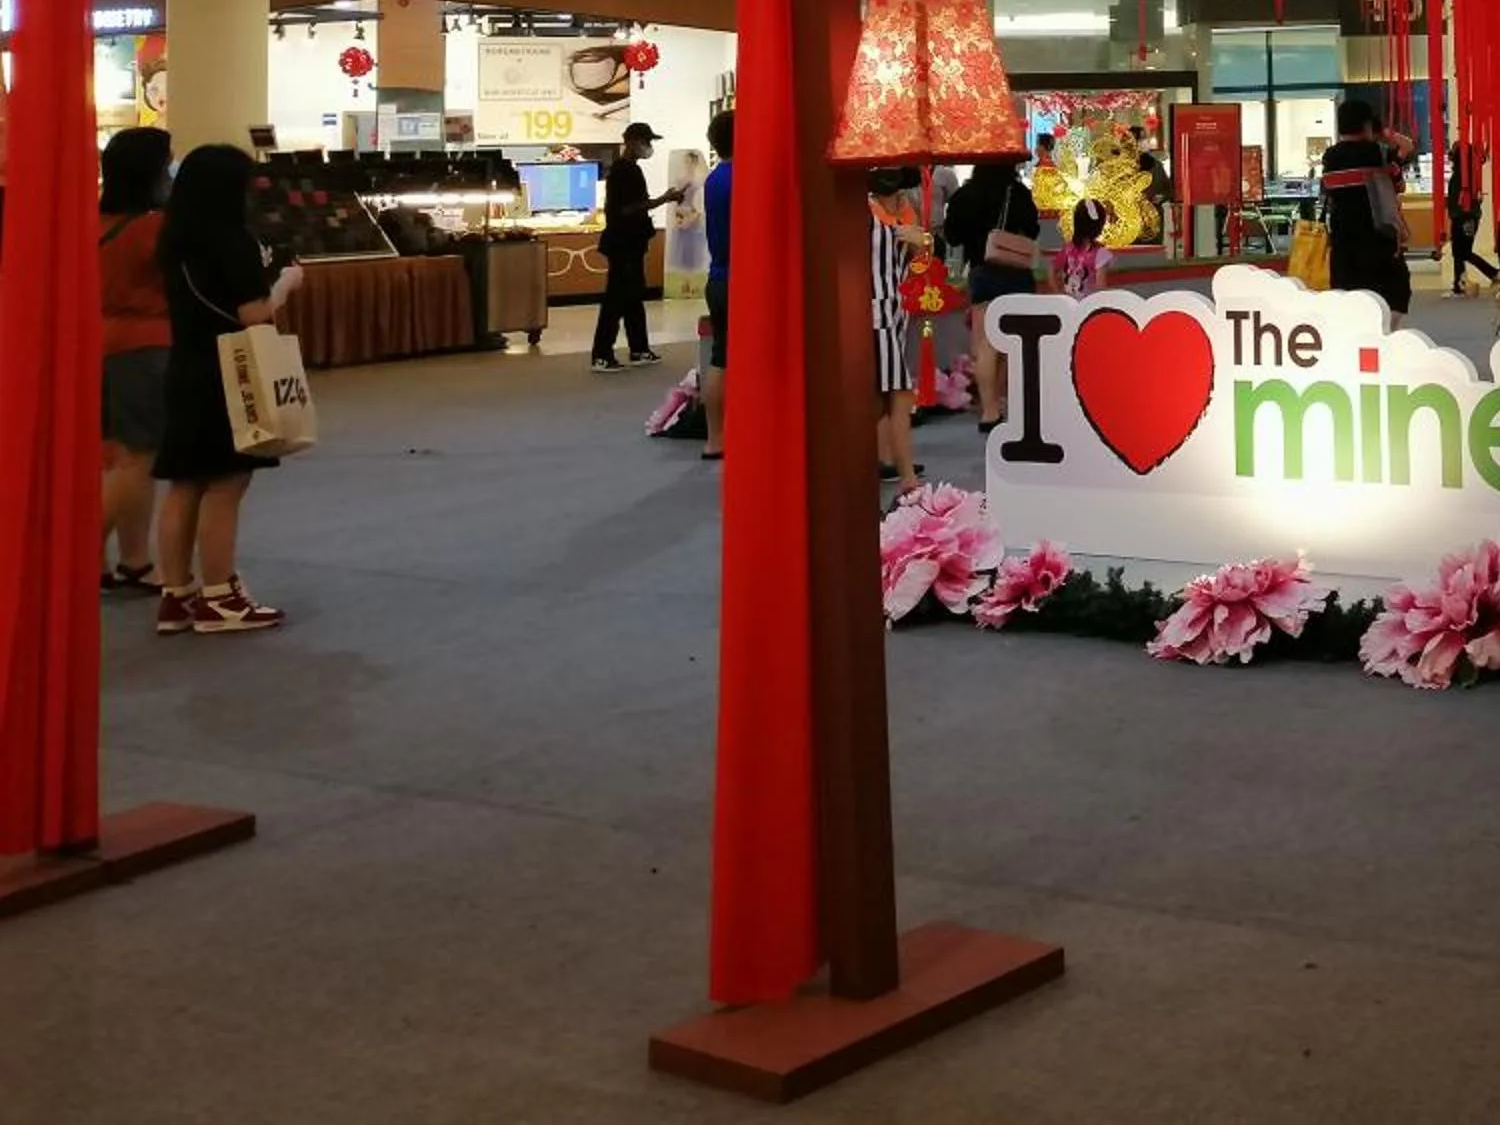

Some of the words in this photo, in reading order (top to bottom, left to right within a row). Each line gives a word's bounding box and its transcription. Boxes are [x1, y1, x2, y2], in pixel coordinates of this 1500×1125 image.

[523, 111, 573, 140] 199
[1225, 309, 1323, 368] The
[999, 313, 1064, 464] I
